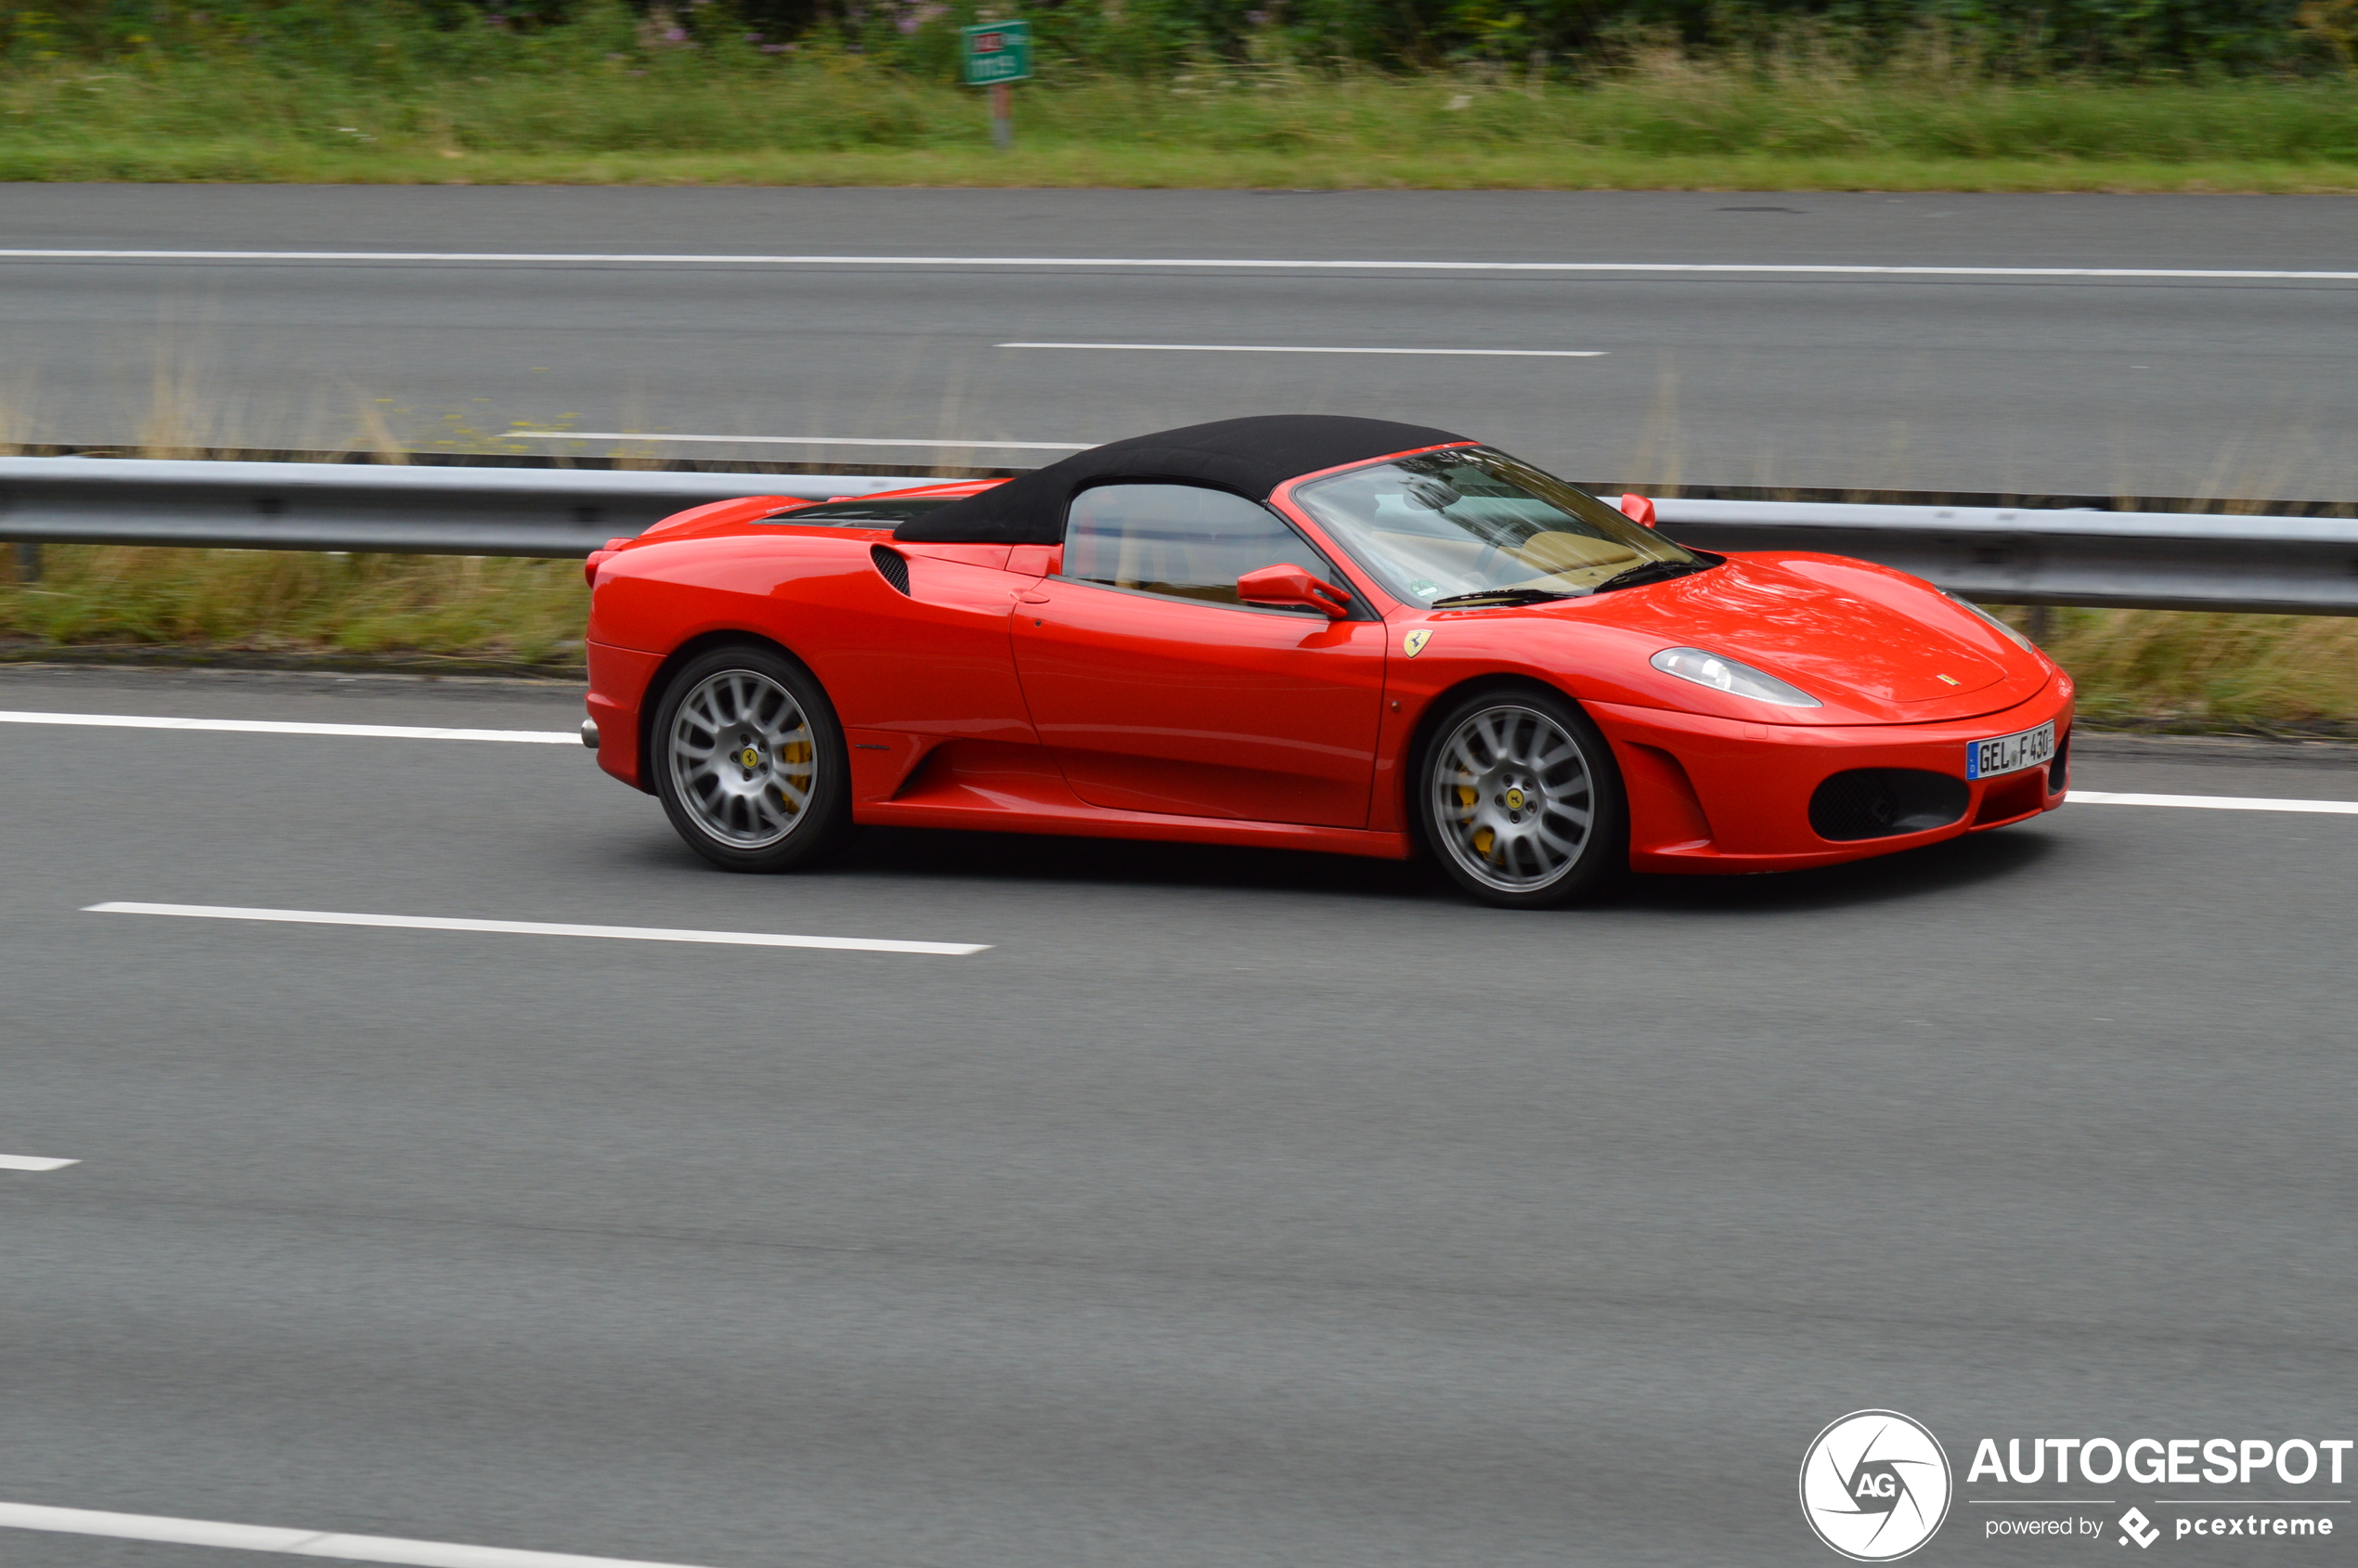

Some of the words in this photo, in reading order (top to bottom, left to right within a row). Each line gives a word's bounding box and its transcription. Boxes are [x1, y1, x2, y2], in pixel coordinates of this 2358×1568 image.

[1980, 742, 2010, 773] GEL
[2019, 735, 2028, 765] F
[2030, 729, 2048, 760] 430
